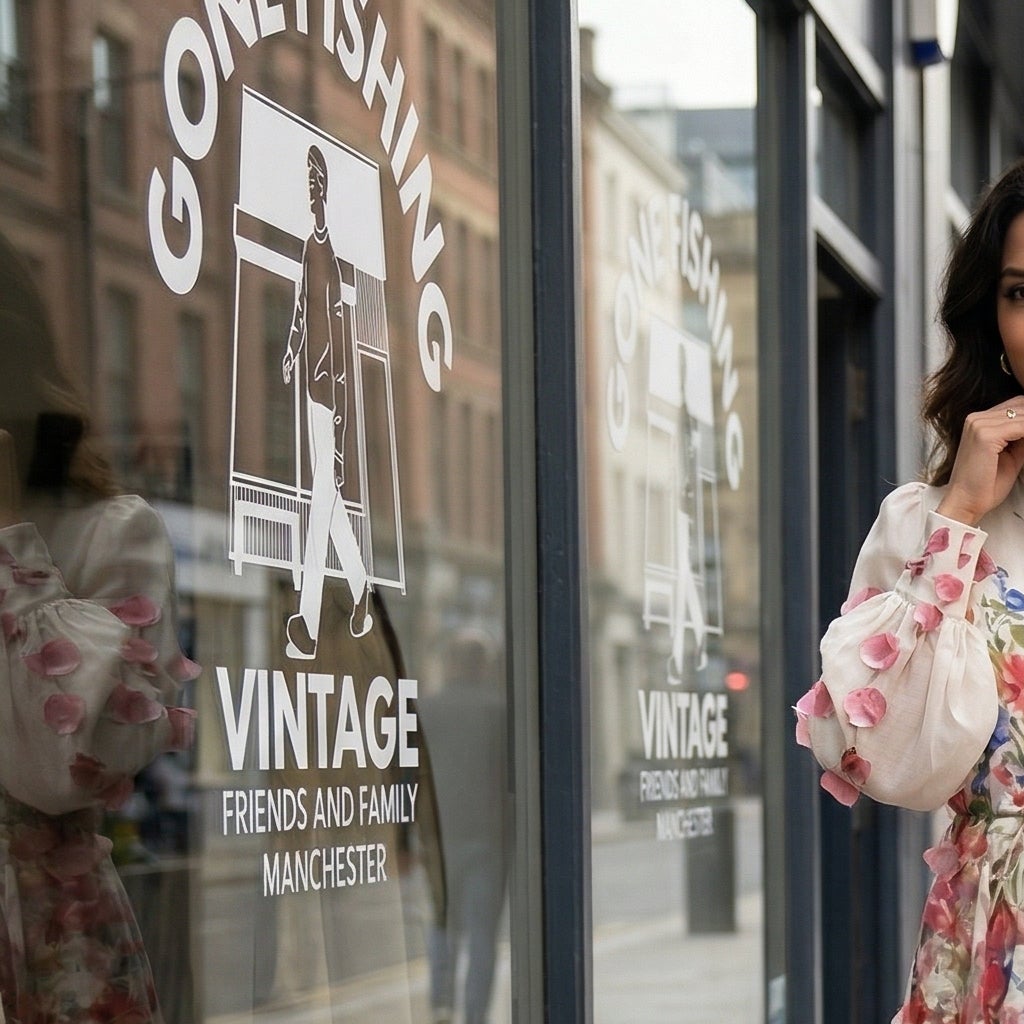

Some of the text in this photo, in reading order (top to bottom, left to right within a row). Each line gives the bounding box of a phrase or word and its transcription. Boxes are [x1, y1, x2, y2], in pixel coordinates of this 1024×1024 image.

[296, 0, 453, 392] ISHING
[668, 192, 744, 491] FISHING
[216, 666, 419, 771] VINTAGE
[638, 689, 729, 760] VINTAGE
[222, 783, 419, 836] FRIENDS AND FAMILY
[263, 843, 388, 897] MANCHESTER
